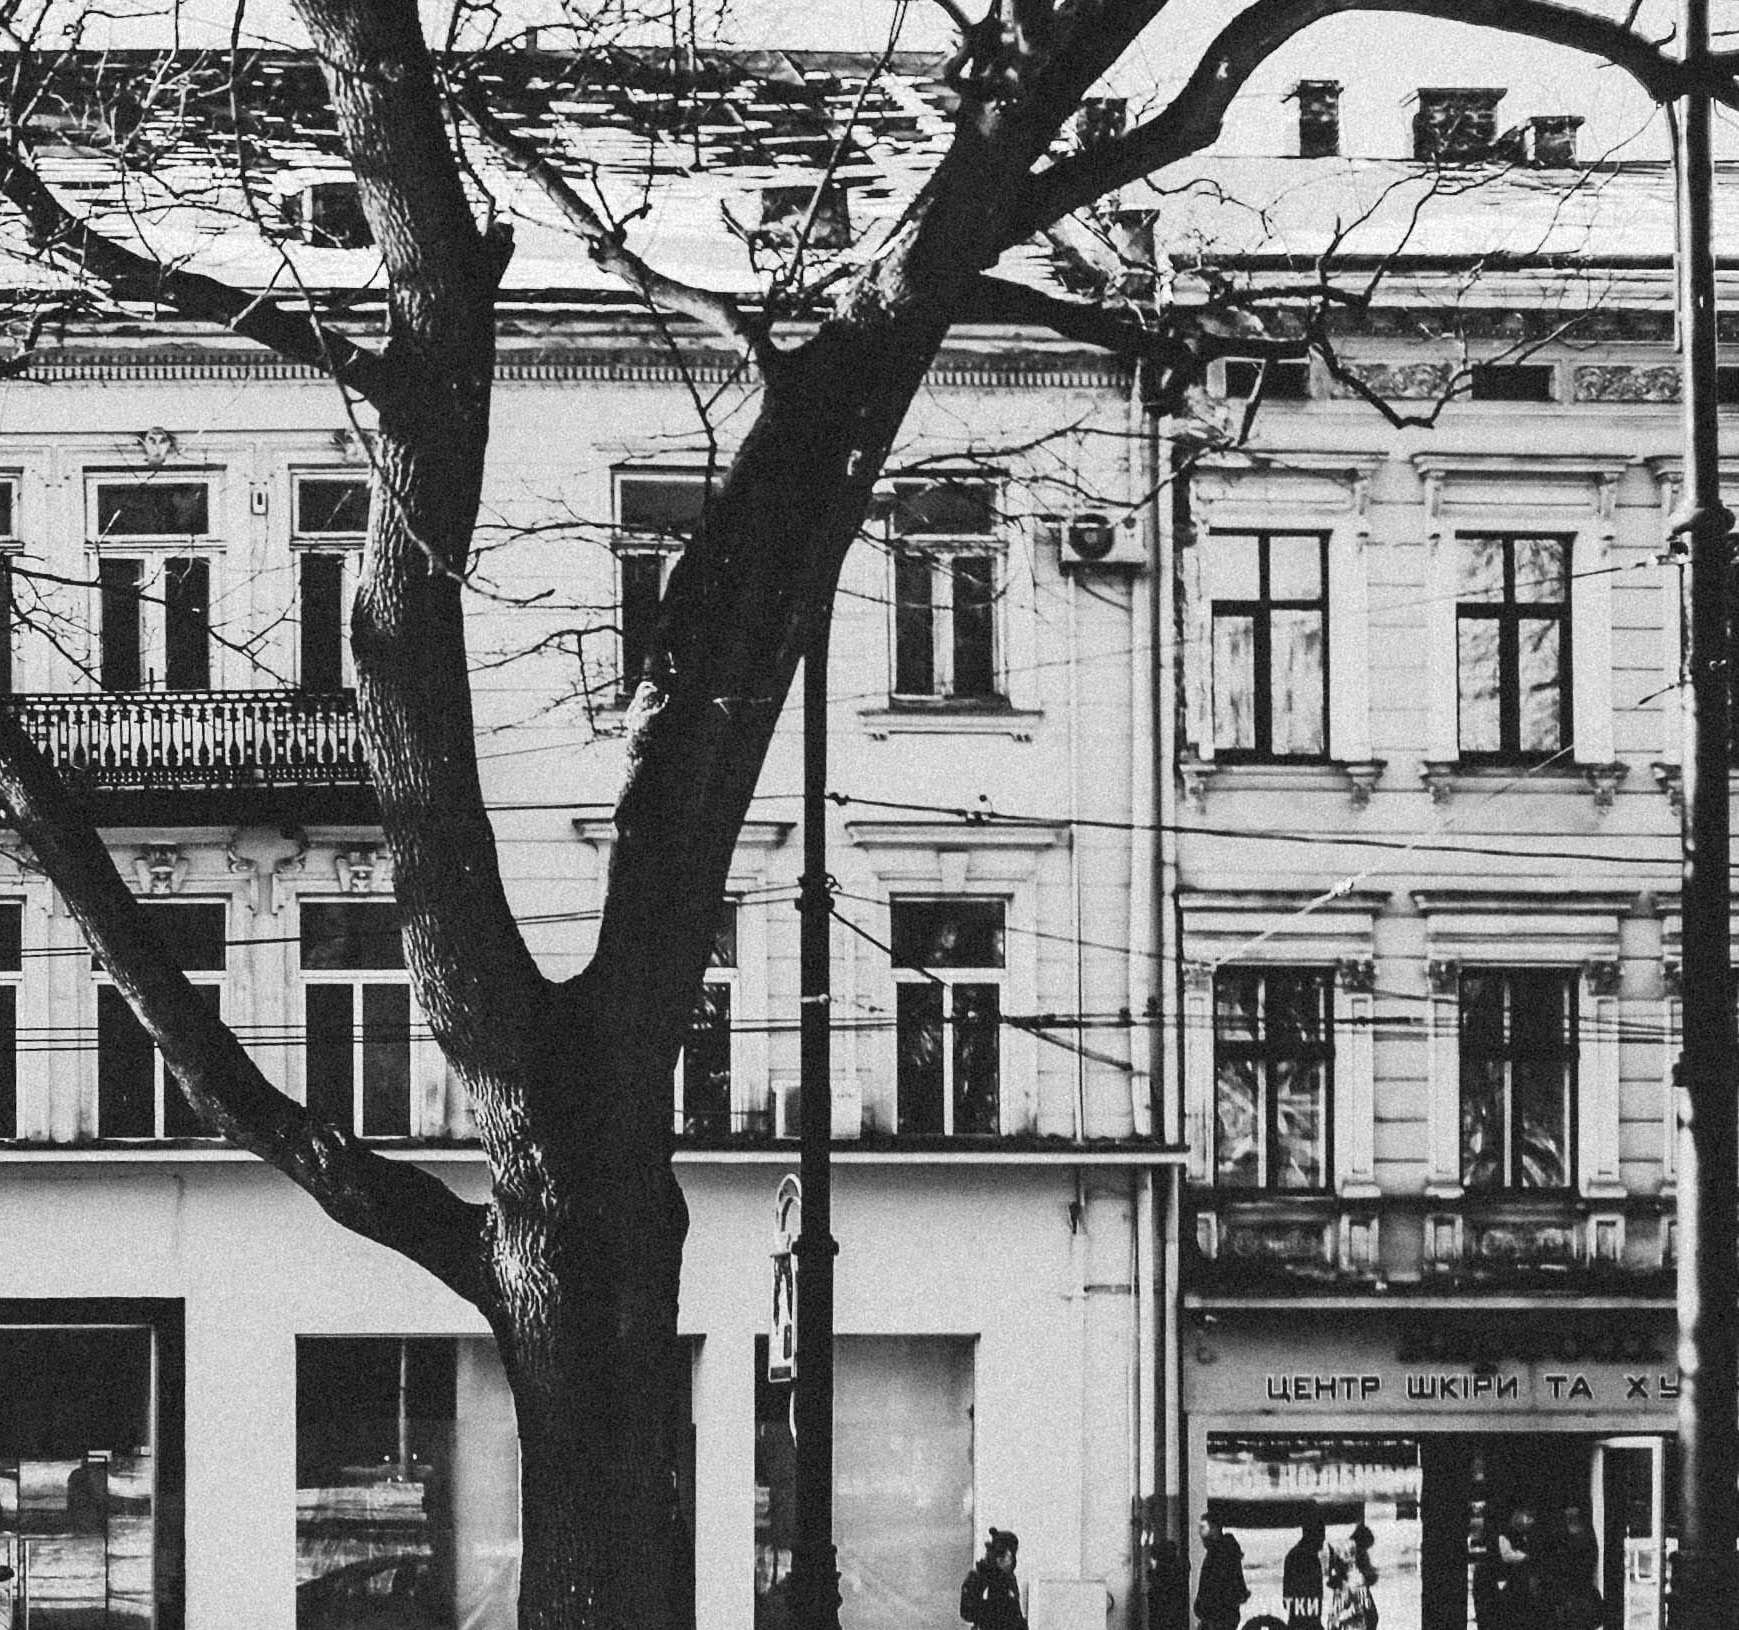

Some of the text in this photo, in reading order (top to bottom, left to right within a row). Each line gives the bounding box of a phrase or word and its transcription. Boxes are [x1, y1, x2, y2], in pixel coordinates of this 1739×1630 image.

[1266, 1373, 1680, 1402] ЦЕНТР ШКІРИ ТА ХУ
